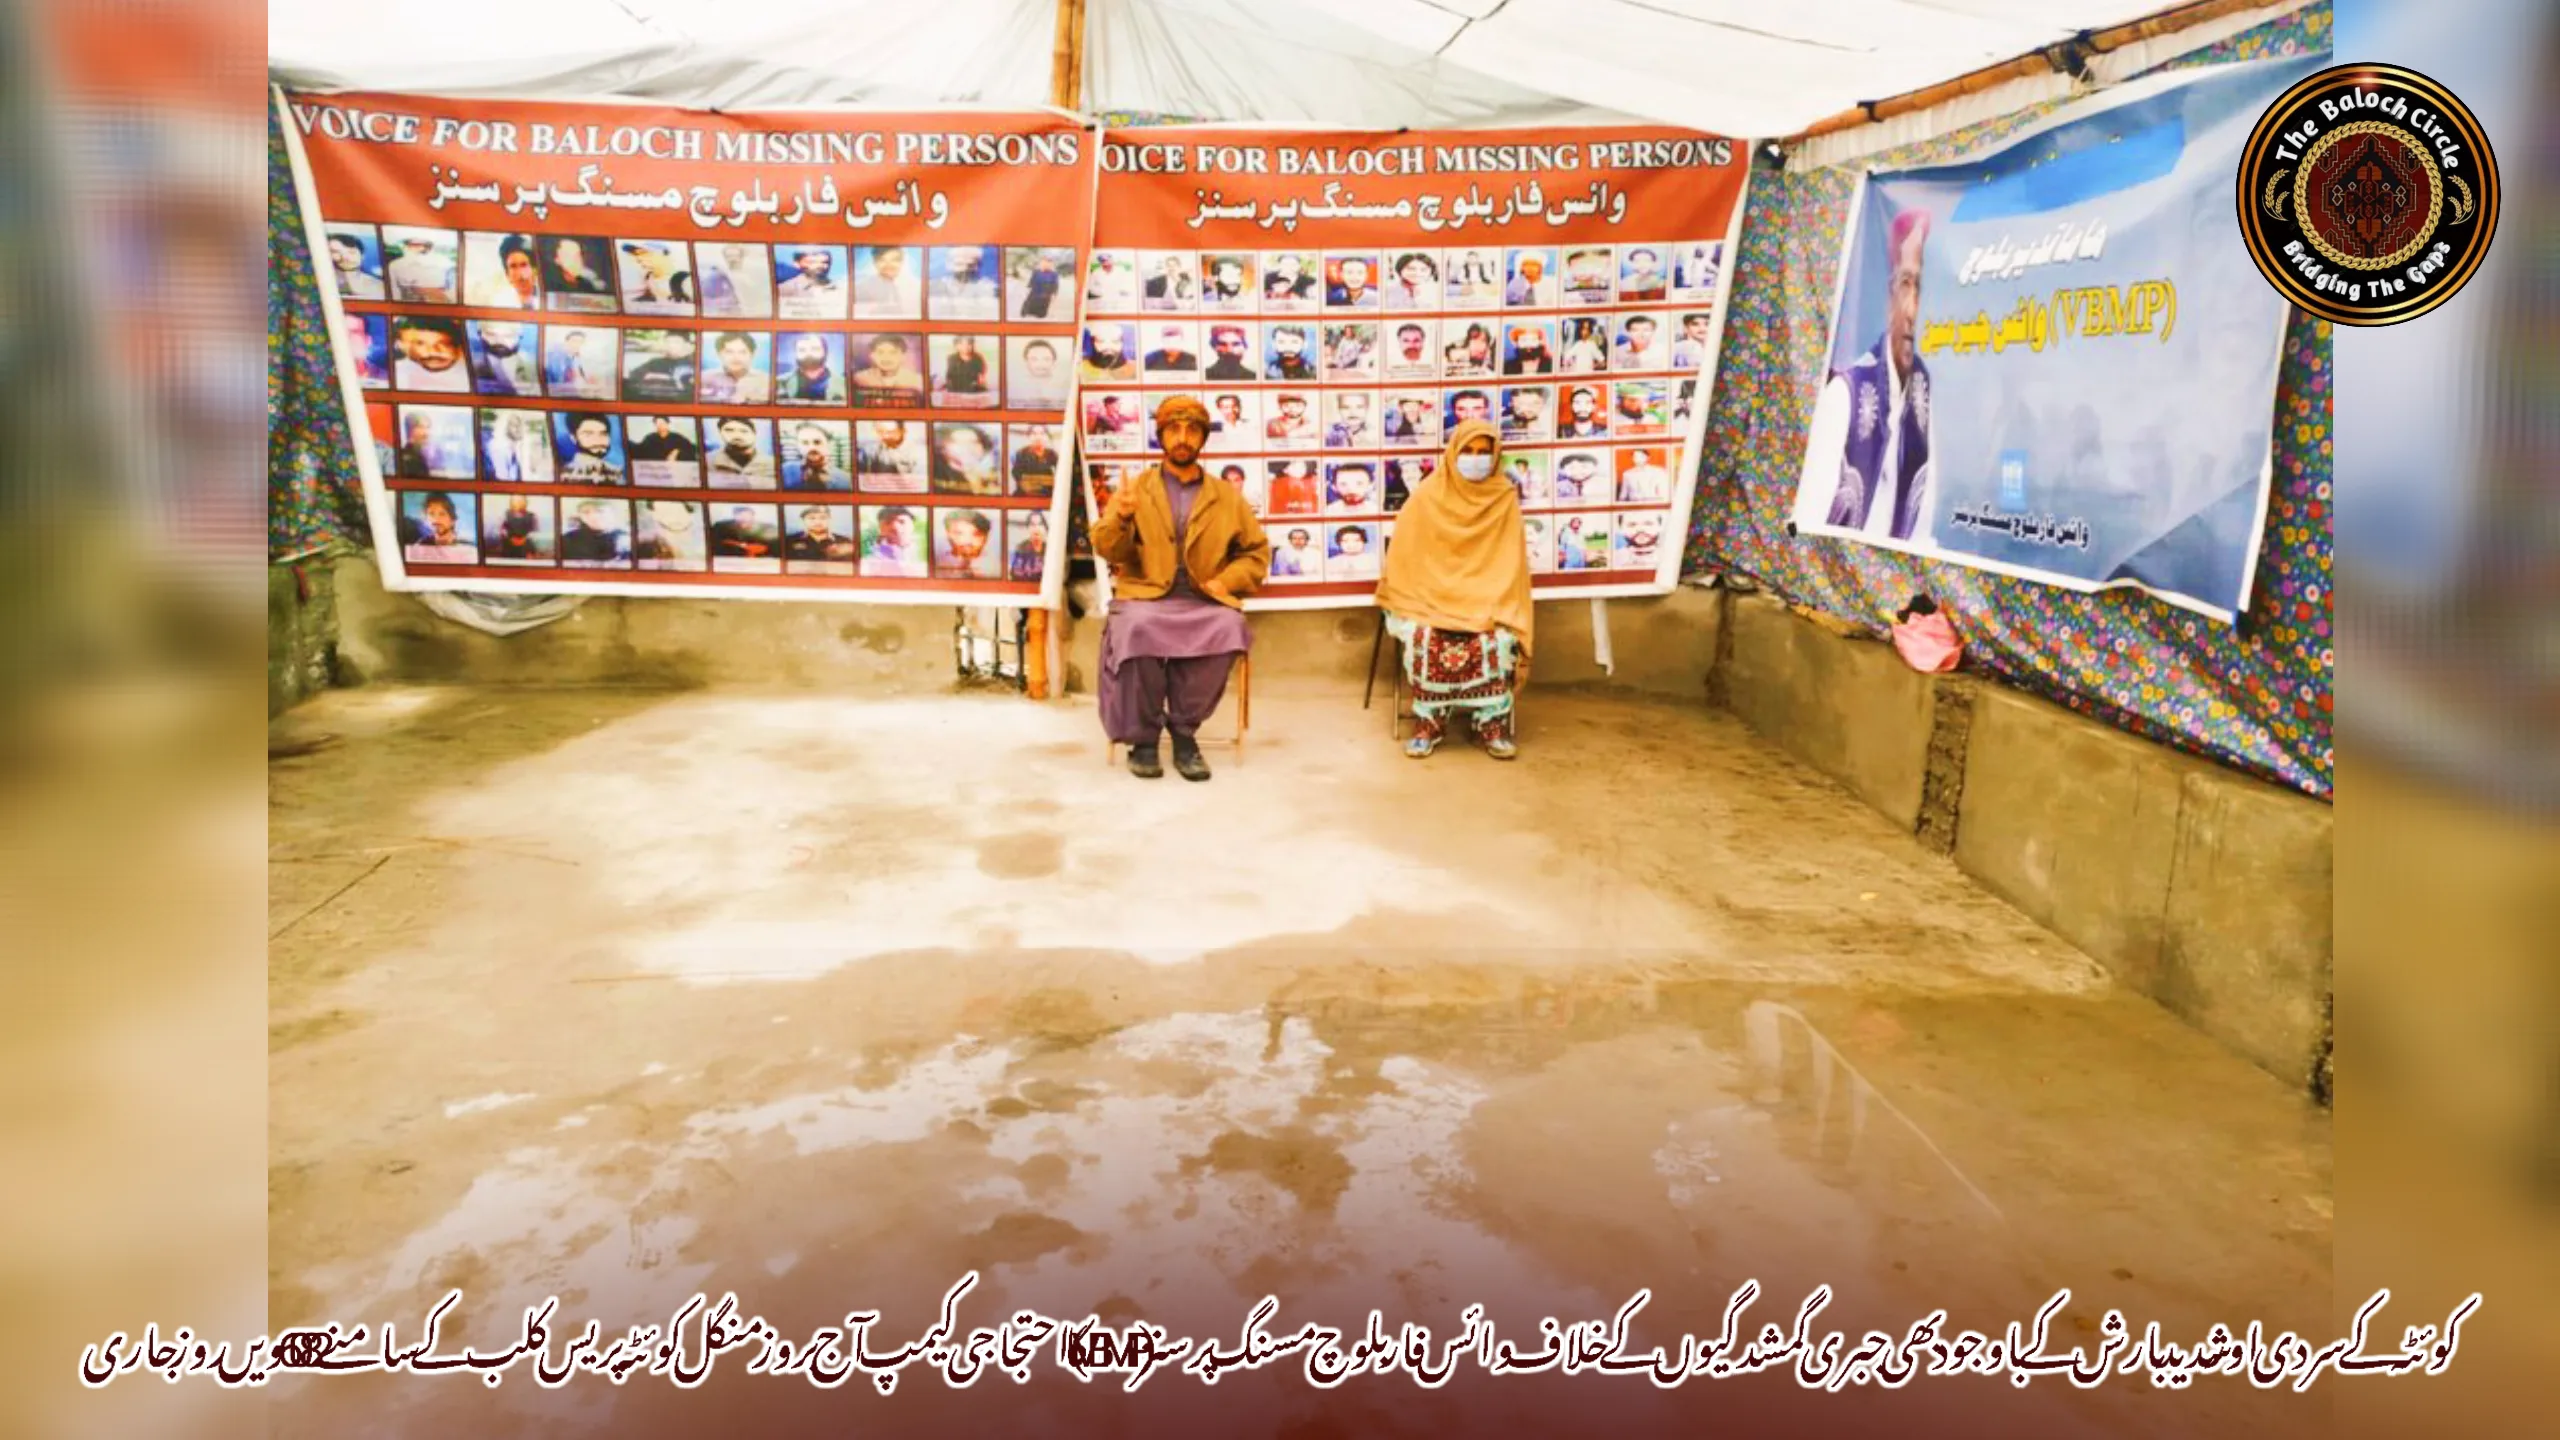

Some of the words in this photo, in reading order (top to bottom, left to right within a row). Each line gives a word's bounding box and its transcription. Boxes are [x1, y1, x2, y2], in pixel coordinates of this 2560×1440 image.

[293, 104, 420, 143] VOICE
[430, 118, 518, 153] FOR
[531, 123, 703, 161] BALOCH
[715, 129, 885, 165] MISSING
[896, 131, 1079, 166] PERSONS
[1100, 145, 1186, 173] OICE
[1196, 145, 1269, 173] FOR
[1278, 145, 1425, 176] BALOCH
[1435, 144, 1579, 173] MISSING
[1588, 139, 1733, 169] PERSONS
[550, 164, 683, 211] مسنگ
[689, 176, 784, 229] بلوچ
[1301, 181, 1413, 218] مسنگ
[1416, 182, 1494, 232] بلوچ
[2050, 278, 2177, 347] (VBMP)
